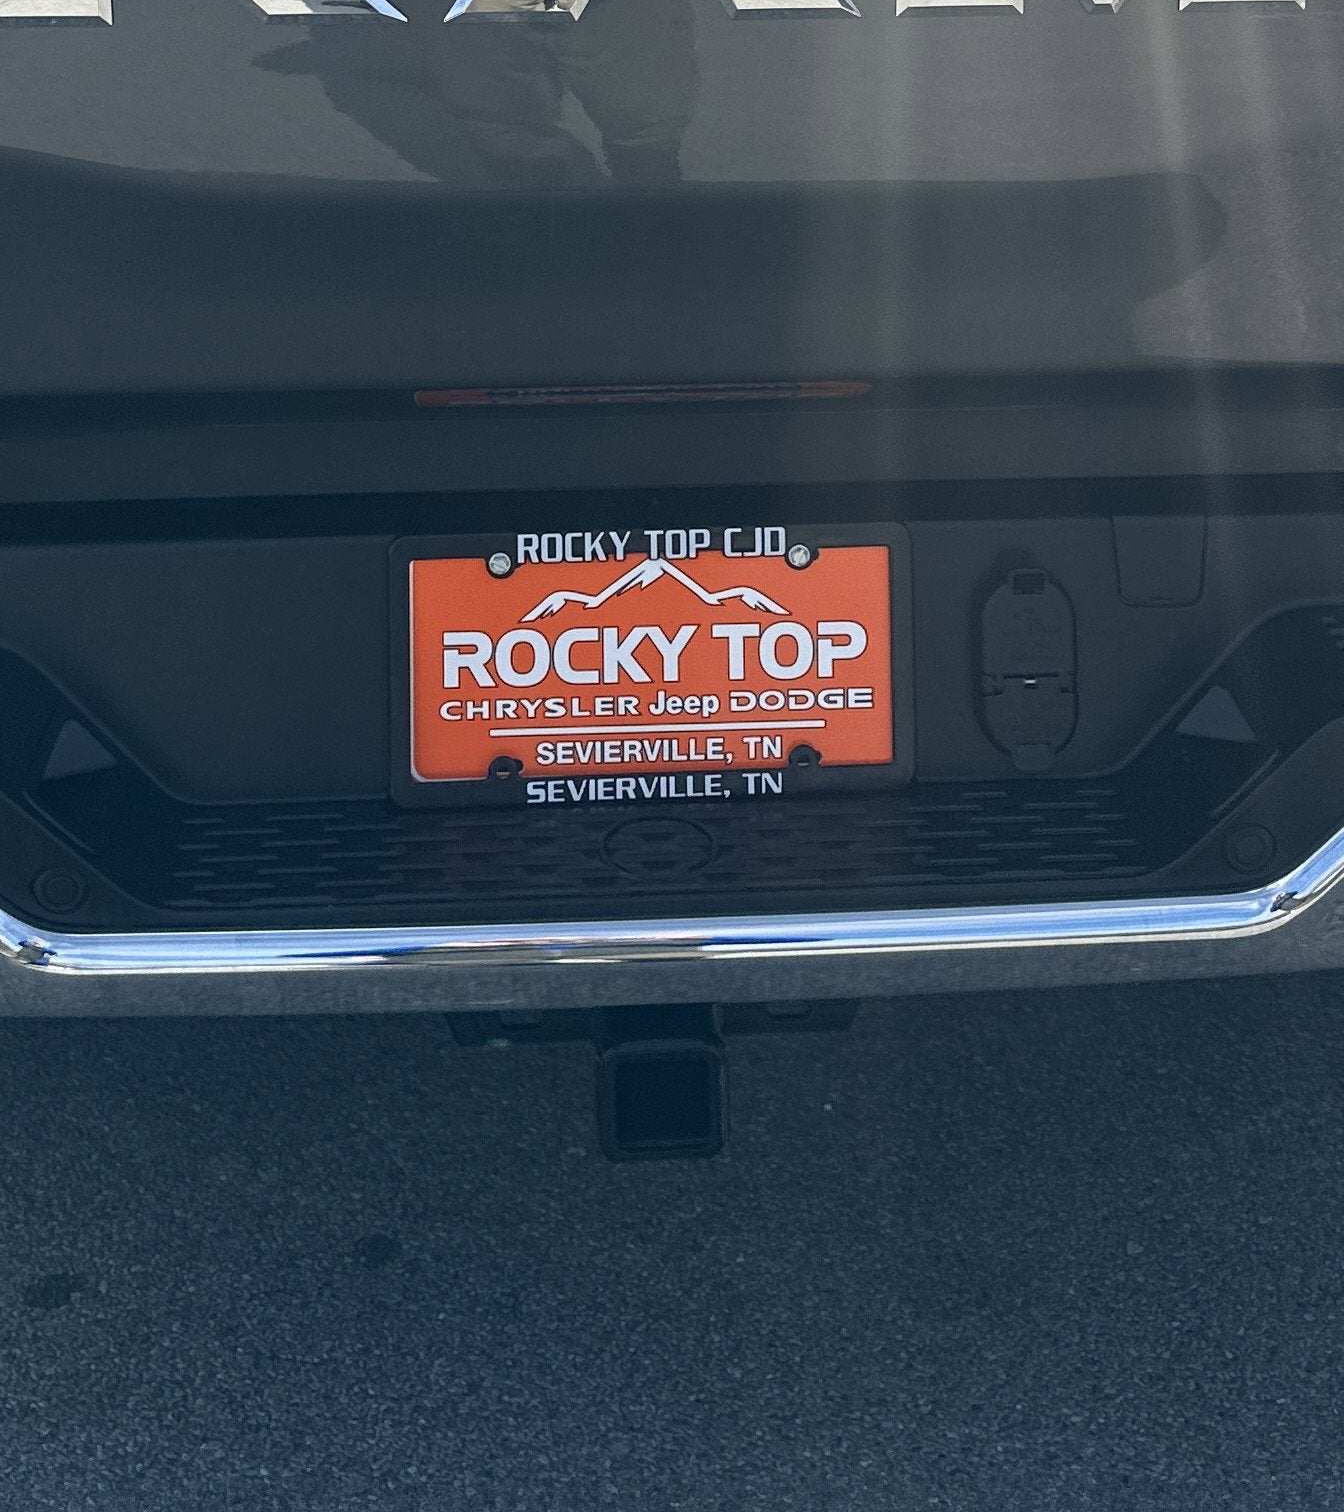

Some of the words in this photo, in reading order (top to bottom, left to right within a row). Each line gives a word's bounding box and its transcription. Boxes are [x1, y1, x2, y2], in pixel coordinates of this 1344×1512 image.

[516, 531, 631, 566] ROCKY
[643, 528, 711, 560] TOP
[724, 526, 787, 558] CJD
[442, 623, 701, 689] ROCKY
[711, 620, 868, 681] TOP
[439, 695, 641, 721] CHRYSLER
[647, 691, 720, 718] Jeep
[729, 687, 874, 713] DODGE
[536, 737, 734, 765] SEVIERVILLE,
[743, 736, 784, 760] TN
[525, 773, 732, 804] SEVIERVILLE,
[741, 771, 784, 795] TN
